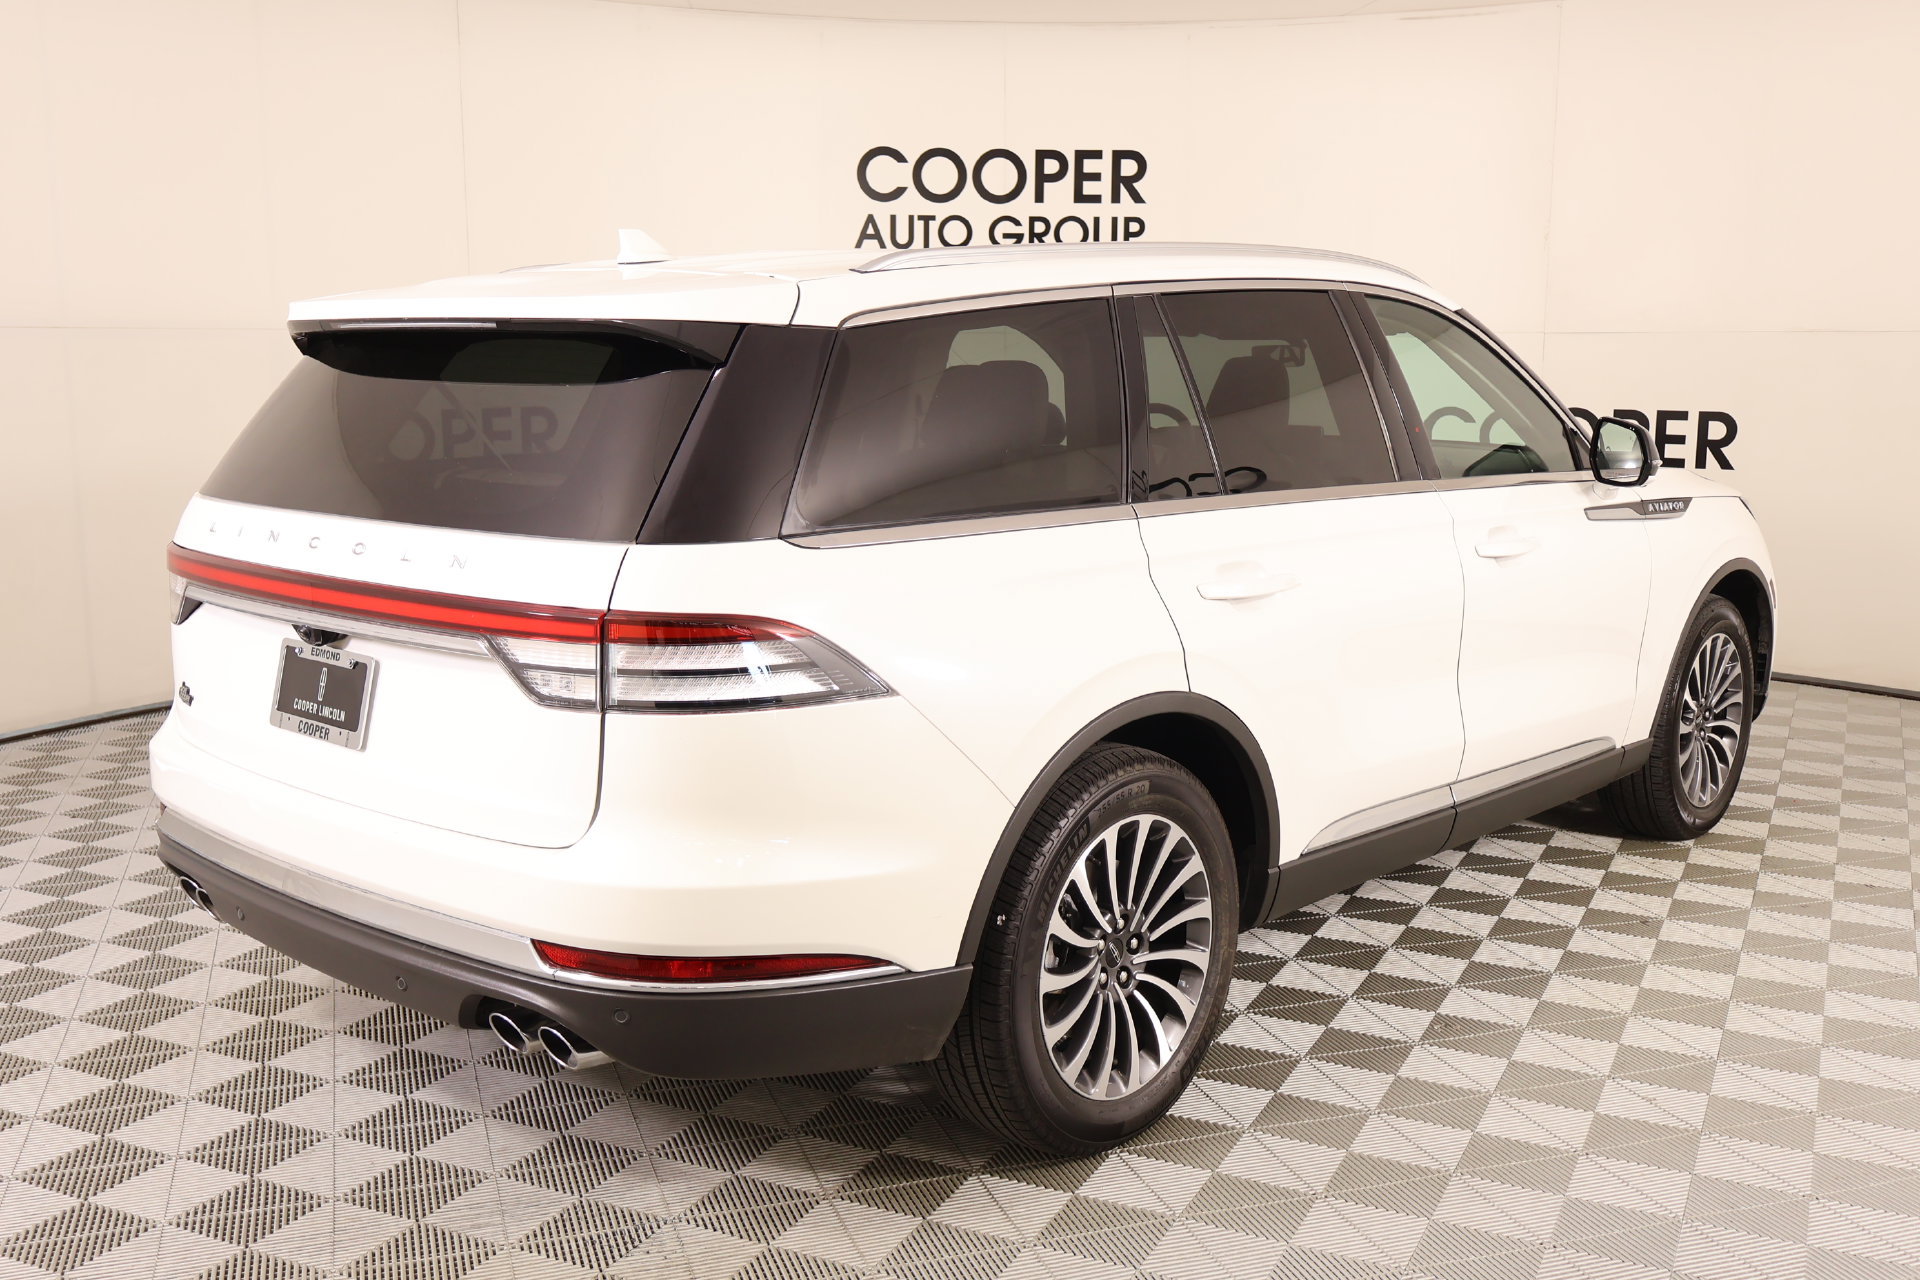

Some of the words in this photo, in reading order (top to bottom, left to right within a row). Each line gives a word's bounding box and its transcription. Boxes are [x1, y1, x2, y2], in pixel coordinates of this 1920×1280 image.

[856, 145, 1147, 204] COOPER
[854, 213, 973, 250] AUTO
[988, 215, 1146, 245] GROUP
[1648, 501, 1685, 512] AVIATOR
[208, 520, 468, 570] LINCOLN
[310, 646, 341, 662] EDMOND
[293, 698, 318, 714] COOPER
[318, 704, 346, 722] LINCOLN
[297, 720, 330, 741] COOPER
[1037, 823, 1088, 922] MICHELIN
